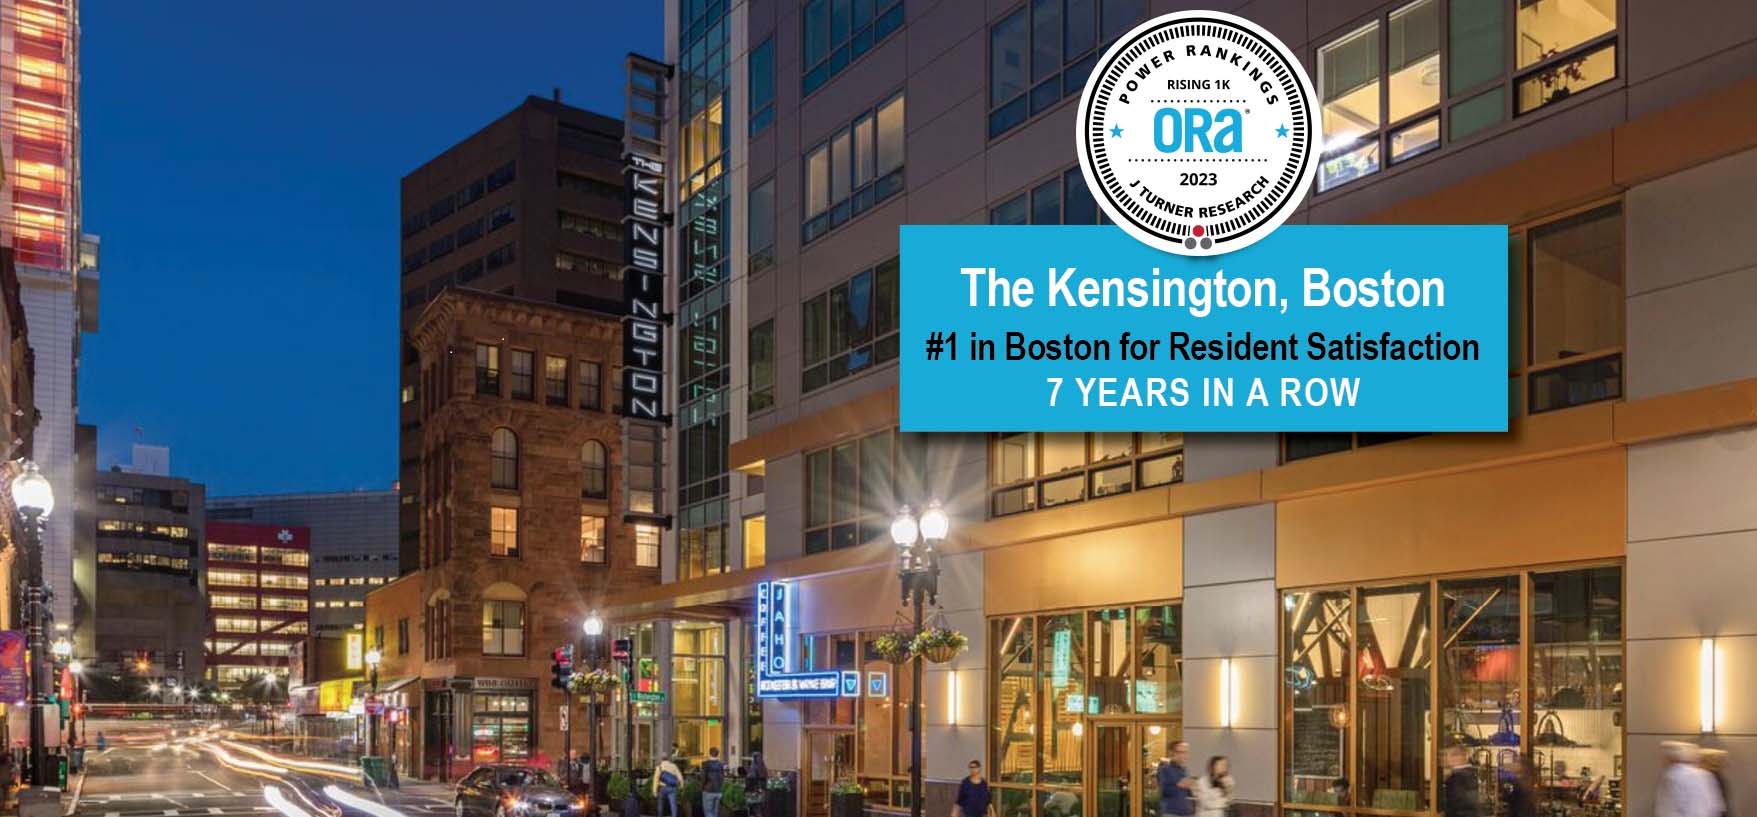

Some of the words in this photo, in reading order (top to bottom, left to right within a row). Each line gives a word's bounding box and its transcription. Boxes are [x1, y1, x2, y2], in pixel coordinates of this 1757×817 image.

[631, 156, 663, 173] THE
[632, 172, 659, 418] KENSINGTON
[774, 588, 785, 669] JAHO
